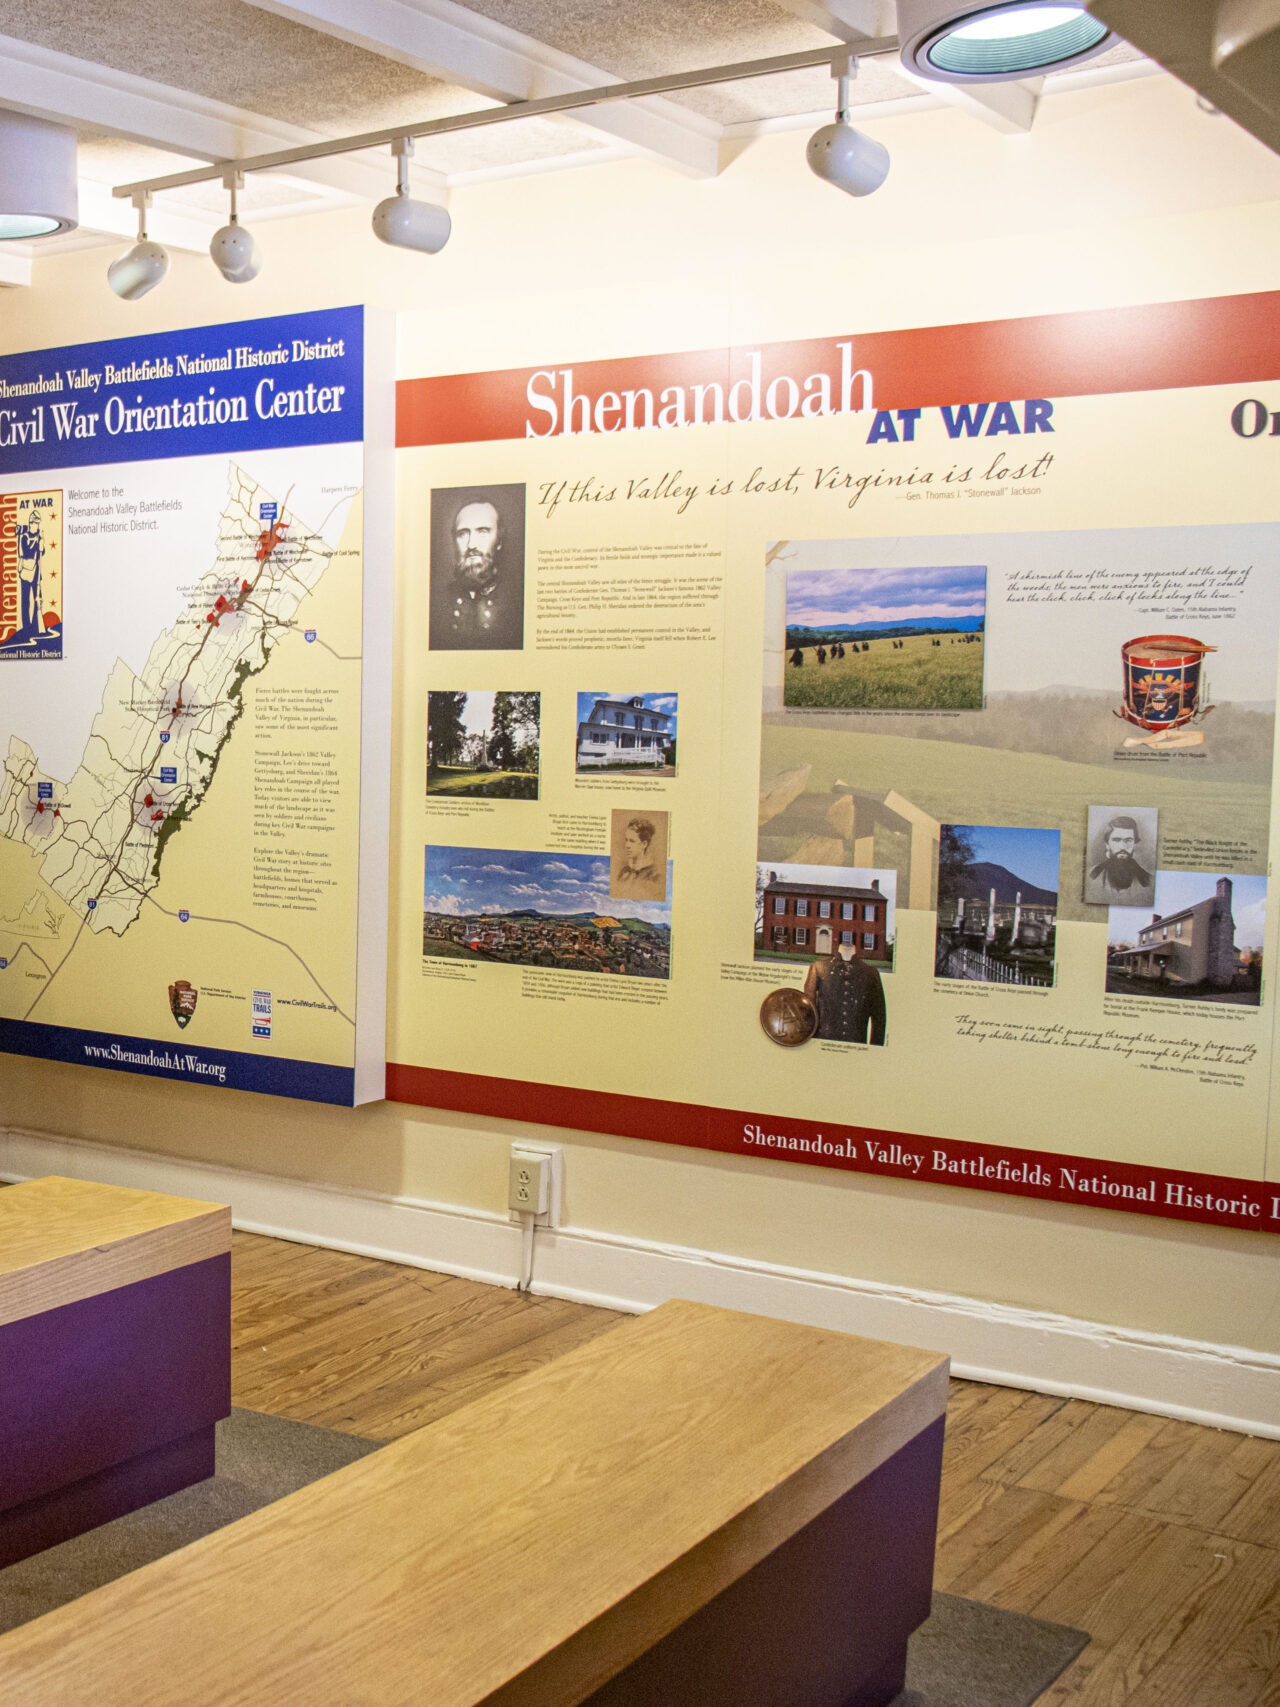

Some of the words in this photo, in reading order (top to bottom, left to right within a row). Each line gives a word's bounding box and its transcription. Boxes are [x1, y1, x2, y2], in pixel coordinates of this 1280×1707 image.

[65, 368, 103, 393] Valley
[104, 357, 173, 385] Battlefields
[176, 349, 232, 376] National
[234, 342, 289, 369] Historic
[291, 336, 345, 362] District
[525, 342, 877, 440] Shenandoah
[50, 401, 99, 441] War
[104, 386, 249, 436] Orientation
[255, 378, 346, 420] Center
[865, 408, 922, 445] AT
[939, 398, 1056, 440] WAR
[68, 489, 100, 501] Welcome
[102, 489, 110, 498] to
[112, 487, 125, 497] the
[538, 480, 568, 519] If
[568, 476, 618, 503] this
[627, 470, 699, 515] Valley
[706, 478, 735, 496] is
[740, 466, 805, 495] lost,
[814, 466, 934, 509] Virginia
[941, 464, 973, 483] is
[981, 451, 1055, 481] lost!
[926, 490, 955, 500] Thomas
[1010, 486, 1042, 496] Jackson
[19, 499, 31, 510] AT
[32, 498, 55, 509] WAR
[68, 504, 114, 518] Shenandoah
[116, 503, 138, 516] Valley
[140, 500, 182, 513] Battlefields
[68, 524, 98, 535] National
[100, 521, 128, 533] Historic
[130, 519, 160, 531] District.
[1021, 570, 1063, 580] skirmish
[1066, 570, 1082, 579] line
[1085, 569, 1096, 583] of
[1096, 569, 1109, 578] the
[1111, 573, 1139, 583] enemy
[1142, 567, 1188, 582] appeared
[1200, 565, 1214, 576] the
[1216, 566, 1238, 581] edge
[1240, 565, 1253, 581] of
[1007, 582, 1020, 591] the
[1054, 581, 1067, 590] the
[1152, 580, 1161, 588] to
[1186, 578, 1208, 587] and
[1217, 577, 1245, 587] could
[1006, 593, 1025, 602] hear
[1027, 593, 1039, 601] the
[1125, 591, 1137, 605] of
[1137, 590, 1163, 600] locks
[1165, 590, 1192, 606] along
[1194, 590, 1208, 599] the
[19, 649, 41, 659] Historic
[41, 649, 62, 658] District
[252, 1003, 272, 1014] TRAILS
[276, 999, 337, 1012] www.CivilWarTrails.org
[956, 1028, 986, 1043] taking
[988, 1030, 1017, 1041] shelter
[1020, 1032, 1054, 1044] behind
[1113, 1042, 1133, 1059] long
[1135, 1047, 1170, 1061] enough
[1171, 1050, 1181, 1058] to
[1181, 1051, 1201, 1063] fire
[1203, 1054, 1224, 1062] and
[1063, 1029, 1103, 1046] passing
[1105, 1029, 1143, 1046] through
[1144, 1033, 1157, 1043] the
[1203, 1040, 1257, 1061] frequently
[84, 1043, 227, 1083] www.ShenandoahAtWar.org
[742, 1123, 857, 1160] Shenandoah
[864, 1141, 925, 1174] Valley
[931, 1150, 1051, 1187] Battlefields
[1058, 1168, 1156, 1202] National
[1163, 1182, 1261, 1218] Historic
